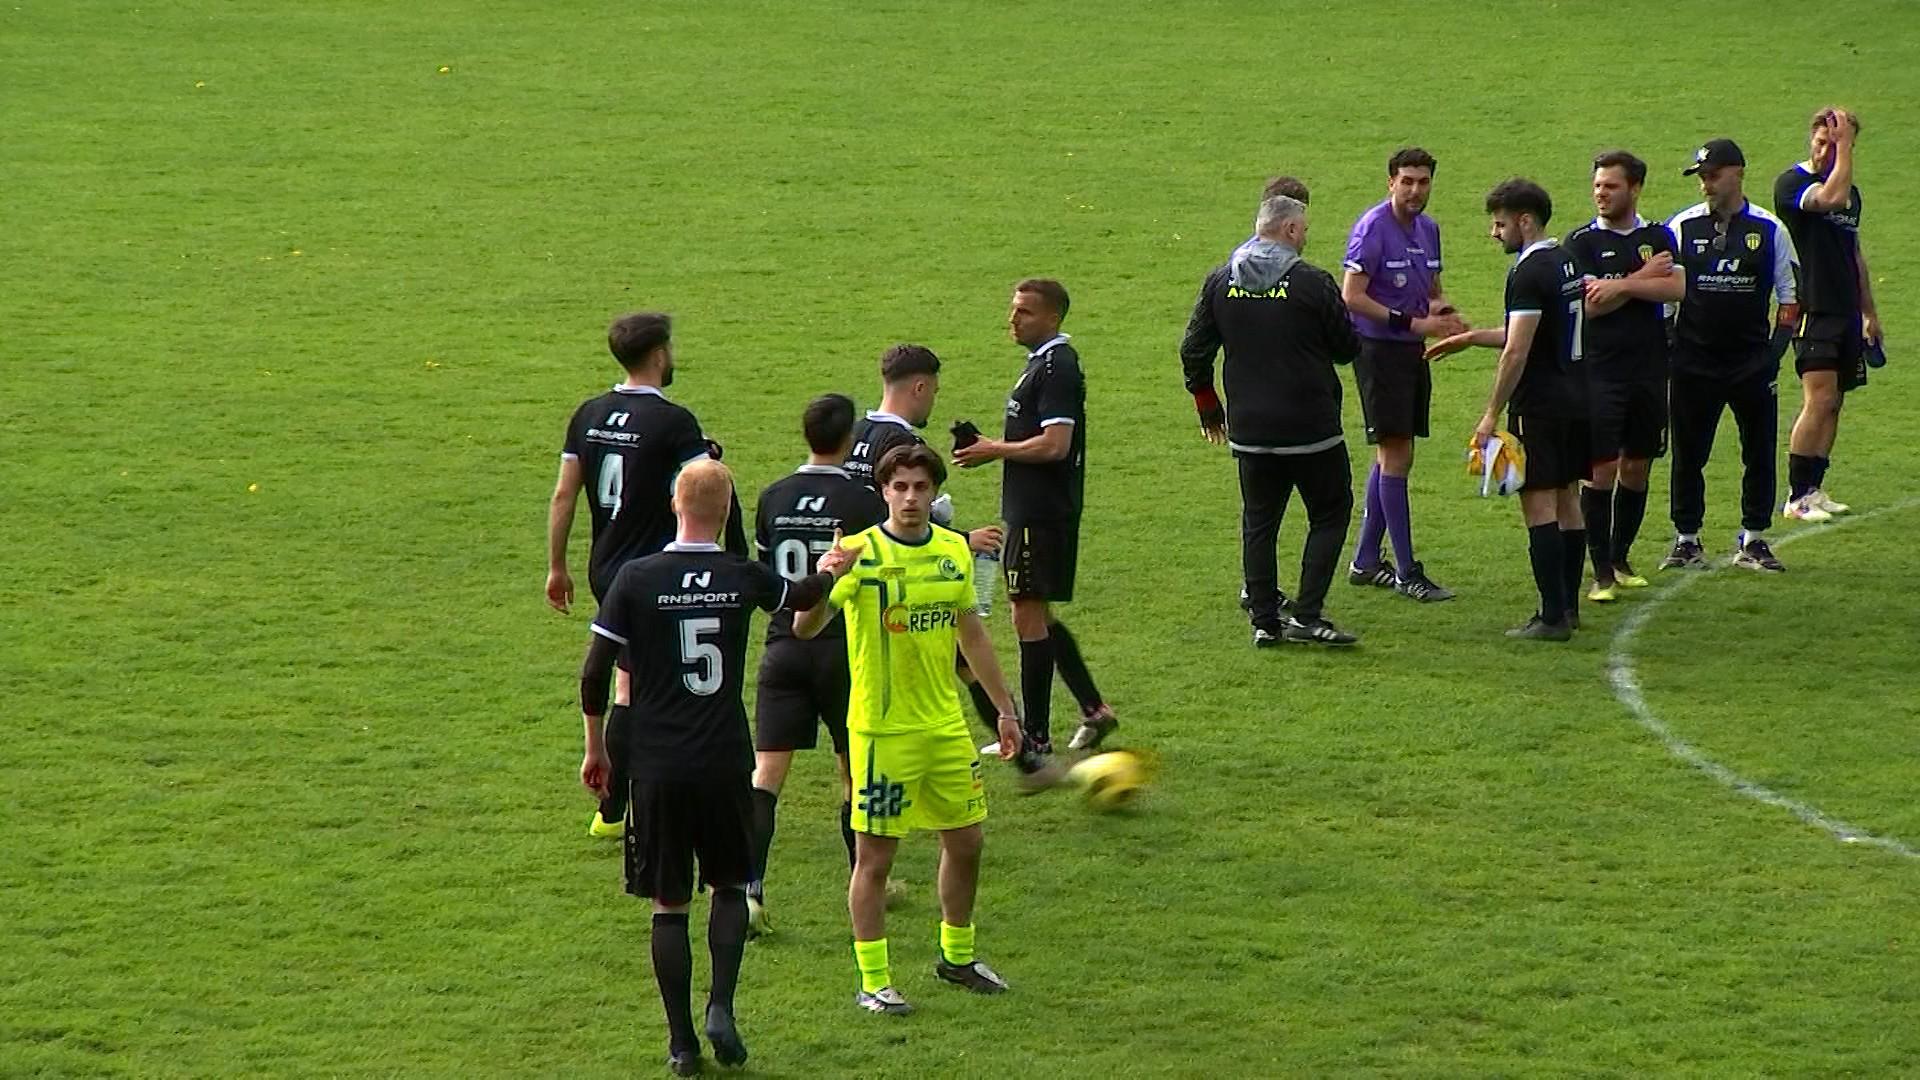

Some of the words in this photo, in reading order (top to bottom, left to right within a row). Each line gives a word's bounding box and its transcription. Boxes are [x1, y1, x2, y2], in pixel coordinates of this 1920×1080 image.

[1227, 287, 1288, 299] ARNA
[598, 452, 624, 520] 4
[657, 592, 740, 604] RNSPORT
[679, 617, 723, 696] 5
